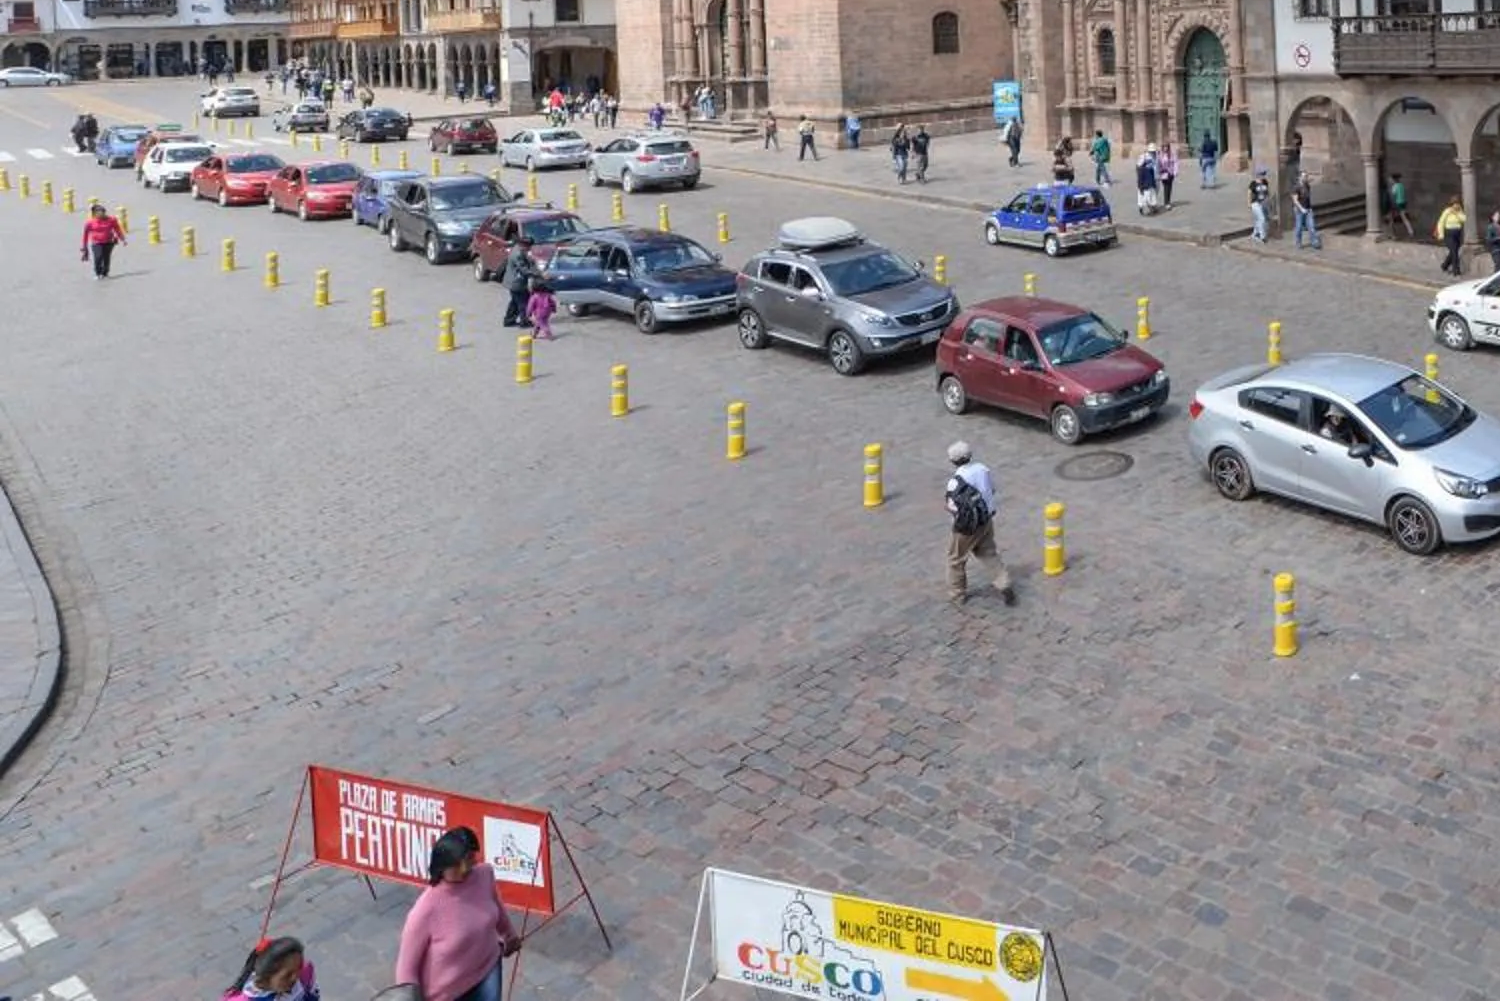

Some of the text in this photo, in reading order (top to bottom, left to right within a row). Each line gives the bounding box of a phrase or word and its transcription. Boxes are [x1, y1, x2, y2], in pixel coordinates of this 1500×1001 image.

[338, 778, 446, 827] PLAZA DE ARMAS
[340, 805, 446, 881] PEATONA
[839, 919, 993, 967] MUNICIPAL DEL CUSCO
[877, 910, 941, 938] GOBIERNO
